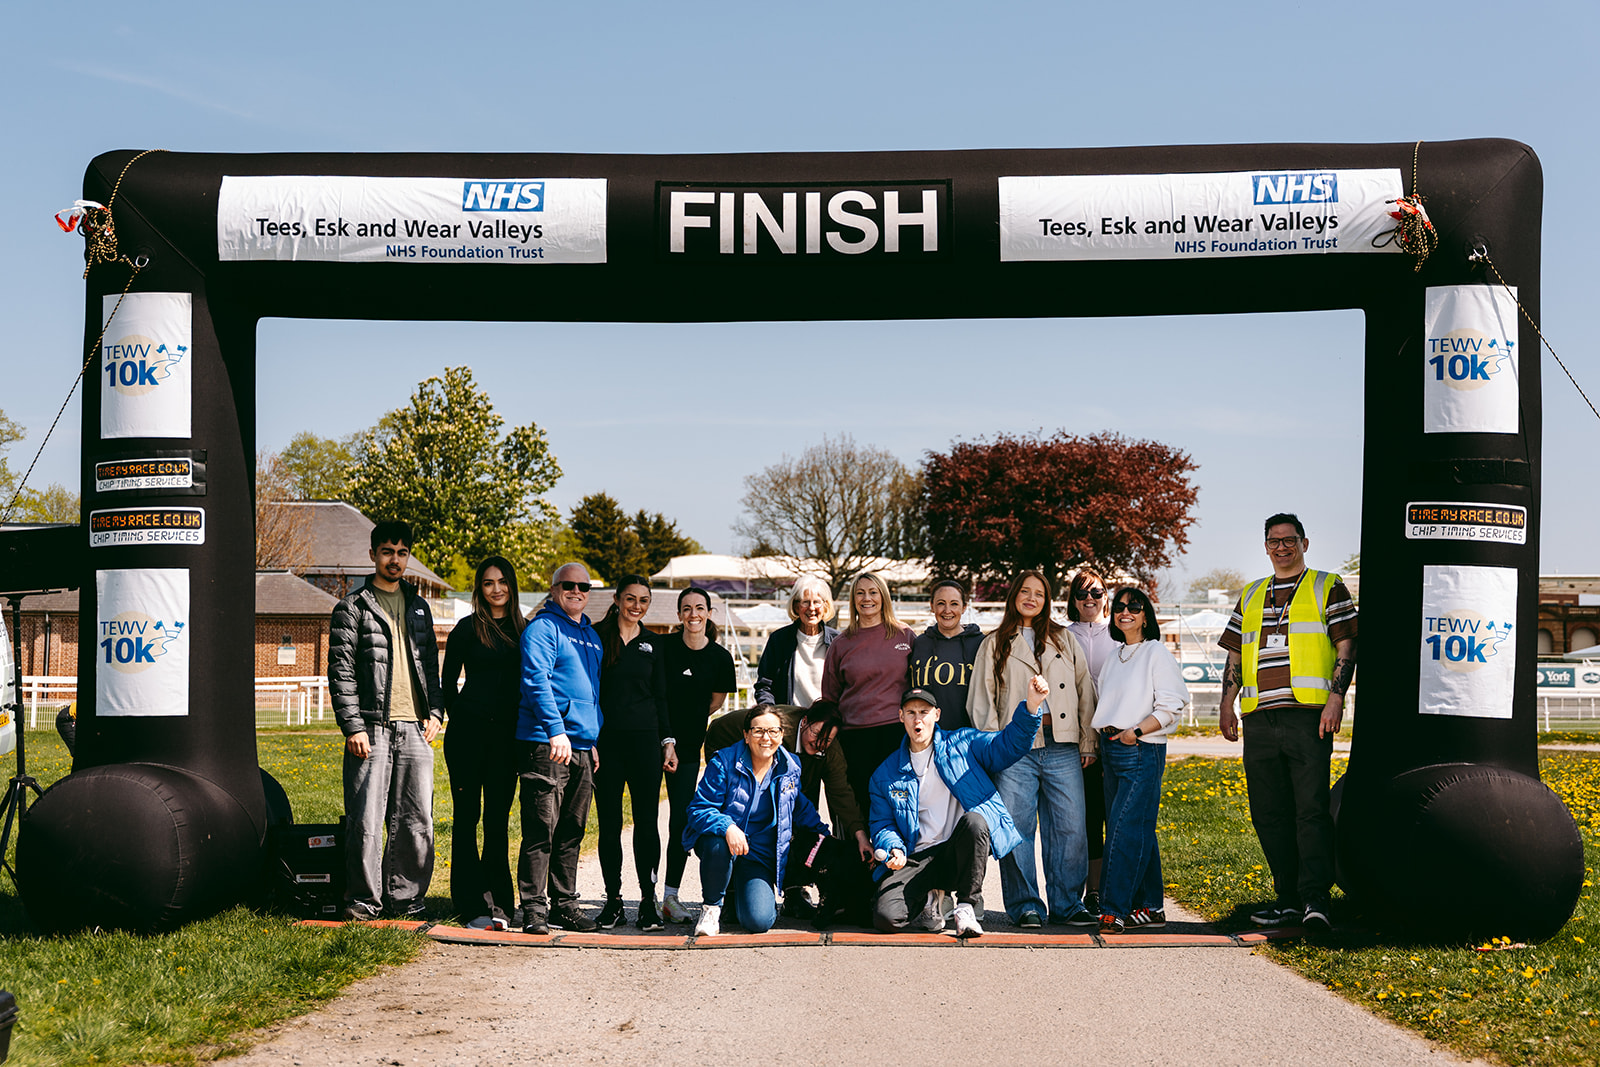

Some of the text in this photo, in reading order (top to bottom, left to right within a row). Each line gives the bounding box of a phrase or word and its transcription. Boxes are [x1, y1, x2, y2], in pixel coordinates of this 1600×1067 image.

[463, 183, 542, 210] NHS
[1255, 174, 1334, 203] NHS
[256, 217, 543, 244] Tees, Esk and Wear Valleys
[670, 190, 938, 254] FINISH
[1039, 211, 1339, 238] Tees, Esk and Wear Valleys
[386, 245, 544, 259] NHS Foundation Trust
[1174, 237, 1338, 253] NHS Foundation Trust
[104, 343, 151, 360] TEWV
[1428, 337, 1483, 353] TEWV
[104, 360, 159, 387] 10k
[1428, 354, 1491, 381] 10k
[98, 477, 188, 490] CHIP TIMING SERVICES
[93, 531, 199, 544] CHIP TIMING SERVICES
[1412, 526, 1523, 541] CHIP TIMING SERVICES
[100, 620, 148, 636] TEWV
[1425, 617, 1481, 634] TEWV
[100, 637, 156, 664] 10k
[1425, 634, 1487, 663] 10k
[1545, 670, 1571, 682] York
